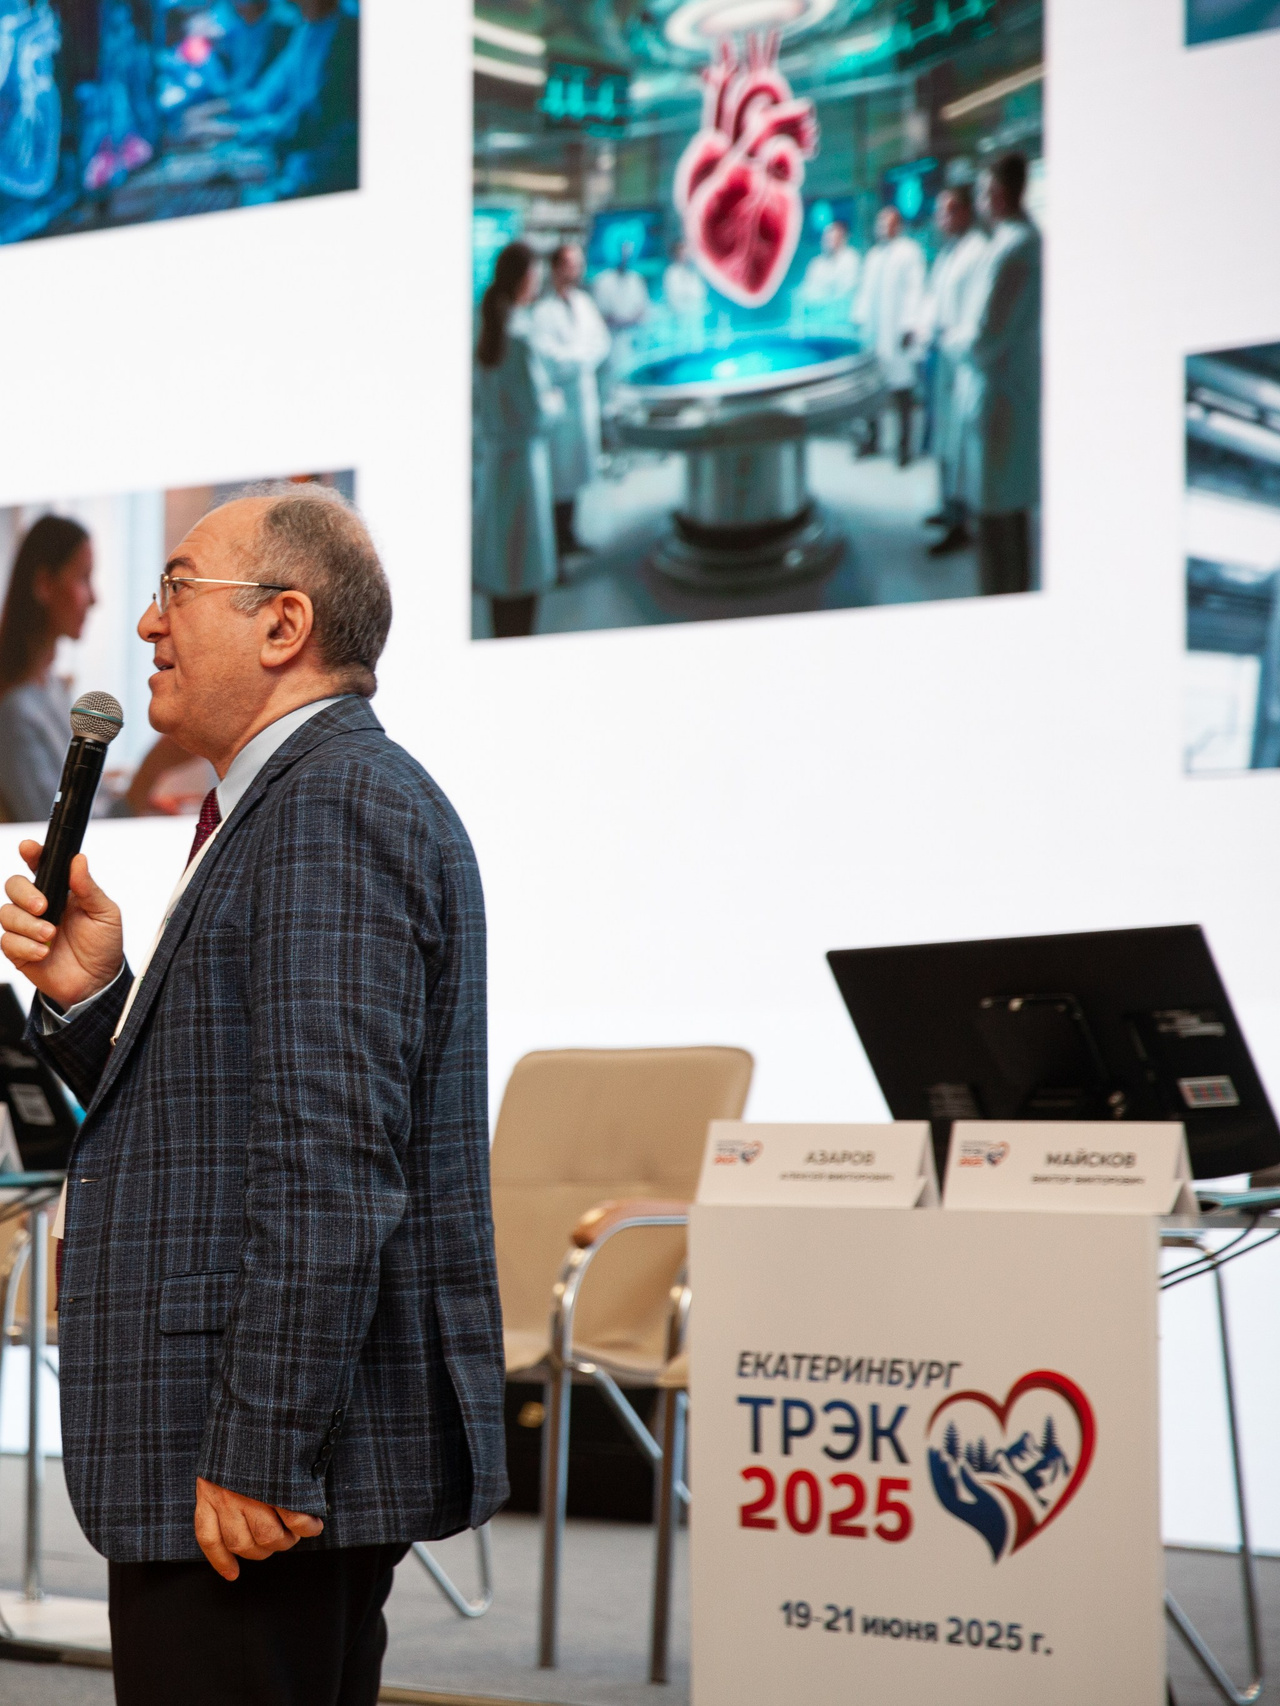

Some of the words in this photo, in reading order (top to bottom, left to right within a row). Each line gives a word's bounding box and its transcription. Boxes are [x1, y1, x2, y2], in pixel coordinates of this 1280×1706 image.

[805, 1150, 876, 1166] АЗАРОВ
[1046, 1148, 1137, 1168] МАЙСКОВ
[737, 1351, 962, 1390] ЕКАТЕРИНБУРГ
[736, 1394, 910, 1465] ТРЭК
[738, 1466, 914, 1543] 2025
[780, 1601, 855, 1635] 19-21
[862, 1615, 938, 1642] июня
[945, 1616, 1024, 1653] 2025
[1029, 1629, 1053, 1656] г.
